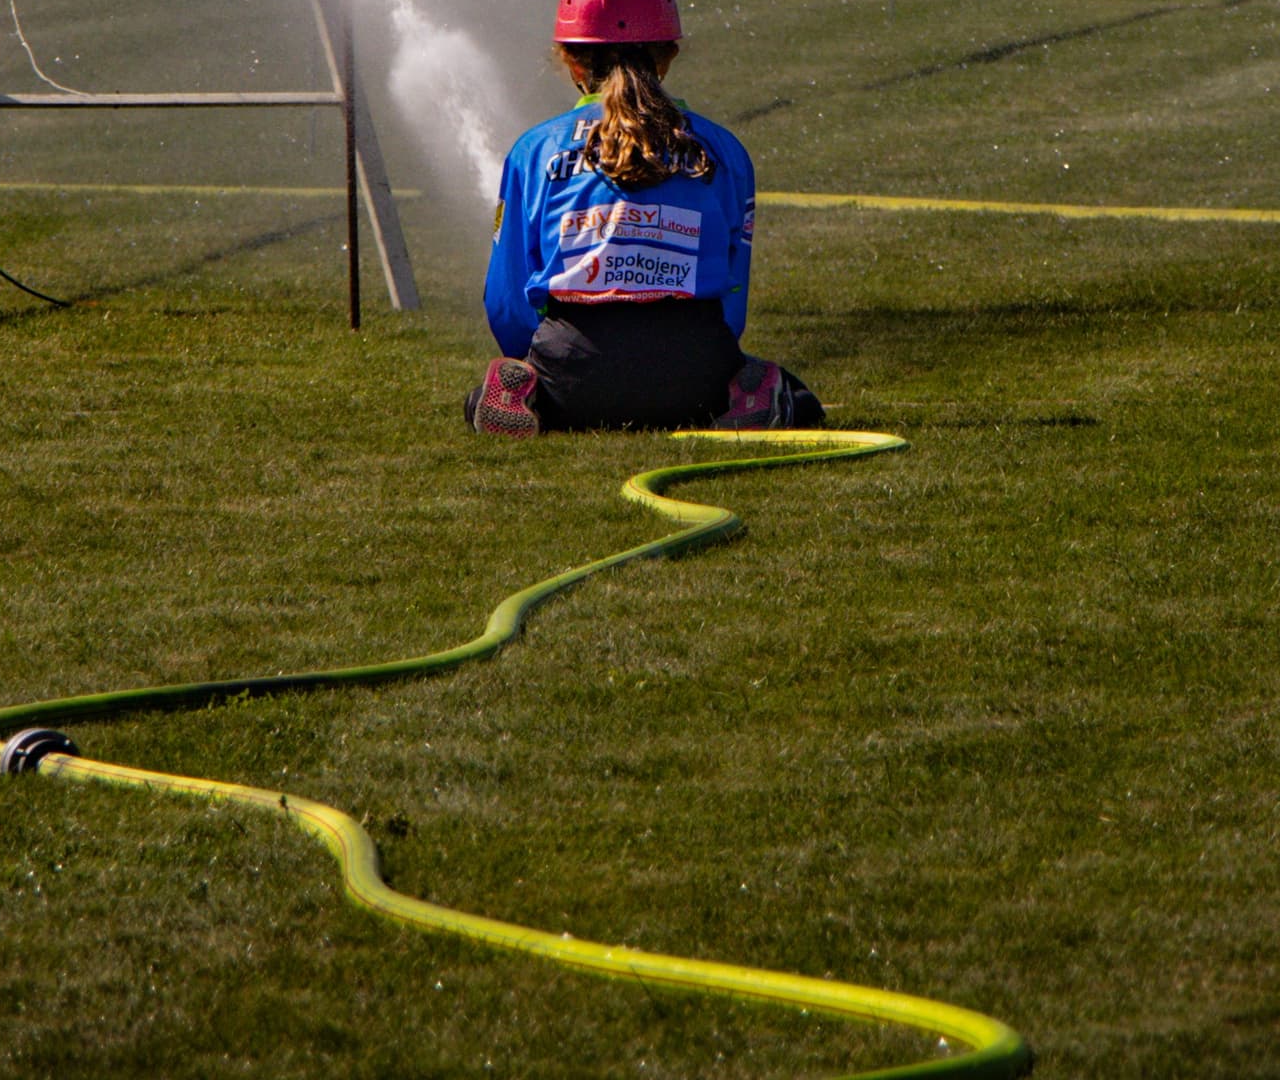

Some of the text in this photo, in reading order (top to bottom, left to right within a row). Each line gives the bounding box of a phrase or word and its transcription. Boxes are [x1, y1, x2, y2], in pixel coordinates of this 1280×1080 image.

[660, 219, 700, 234] Litovel
[606, 253, 691, 279] spokojený
[604, 270, 685, 287] papoušek
